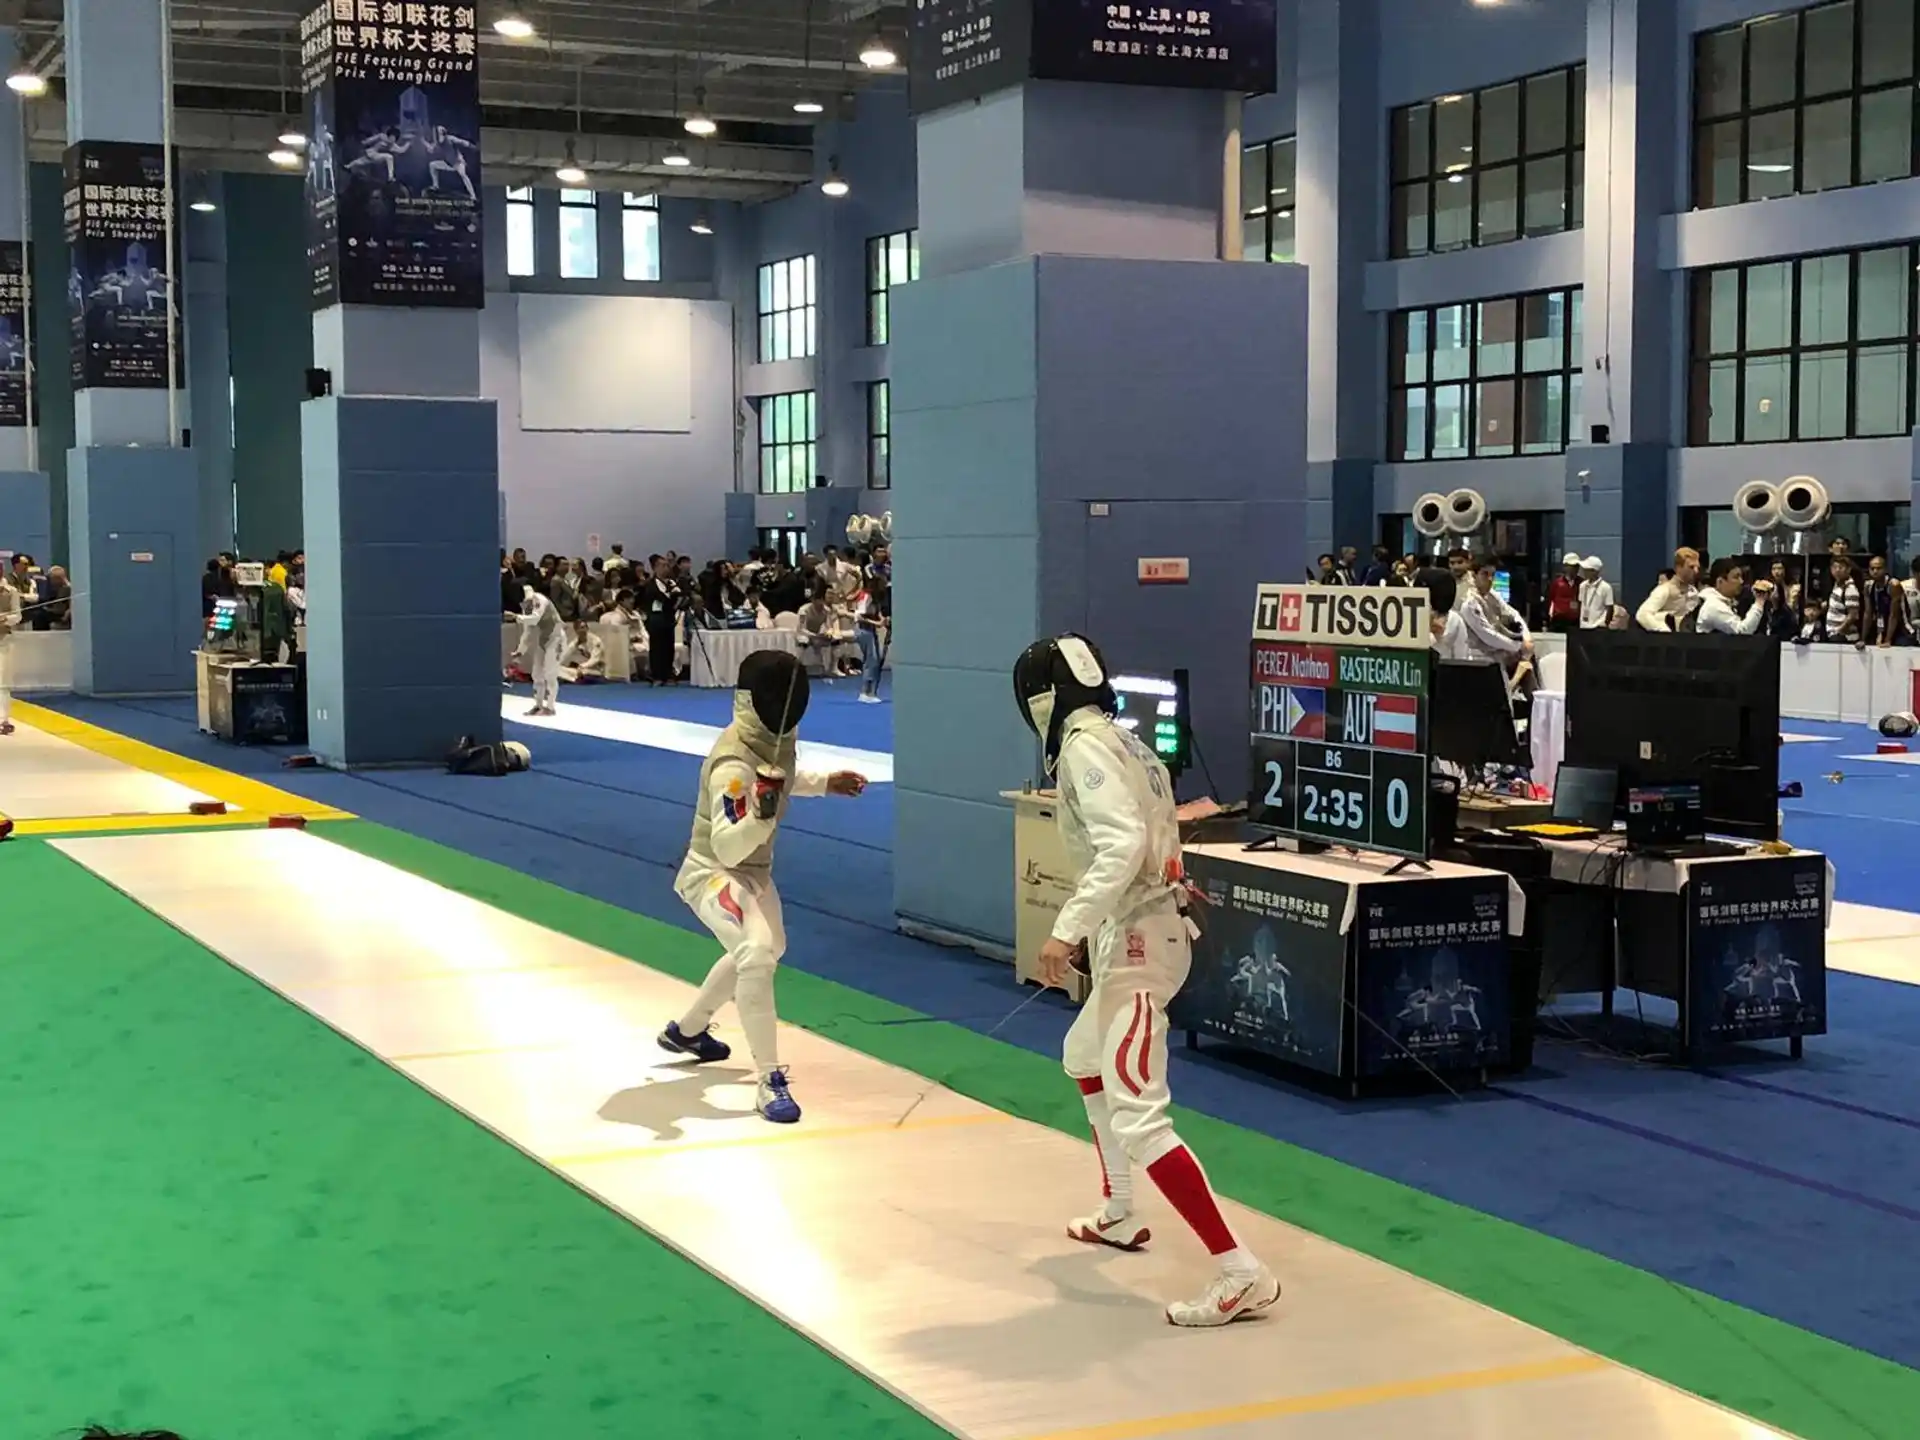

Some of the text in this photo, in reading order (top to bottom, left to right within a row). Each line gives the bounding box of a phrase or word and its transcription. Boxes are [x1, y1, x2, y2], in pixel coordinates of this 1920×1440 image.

[333, 0, 474, 29] 国际剑联花剑
[334, 25, 476, 55] 世界杯大奖赛
[335, 52, 474, 72] FIE Fencing Grand
[335, 66, 449, 85] Prix Shanghai
[1306, 594, 1426, 639] TISSOT
[1257, 650, 1330, 679] PEREZ Nathan
[1340, 656, 1422, 687] RASTEGAR Lin
[1261, 686, 1291, 734] PHI
[1344, 694, 1377, 744] AUT
[1325, 750, 1342, 768] B6
[1264, 761, 1283, 807] 2
[1304, 785, 1364, 830] 2:35
[1387, 778, 1409, 828] 0
